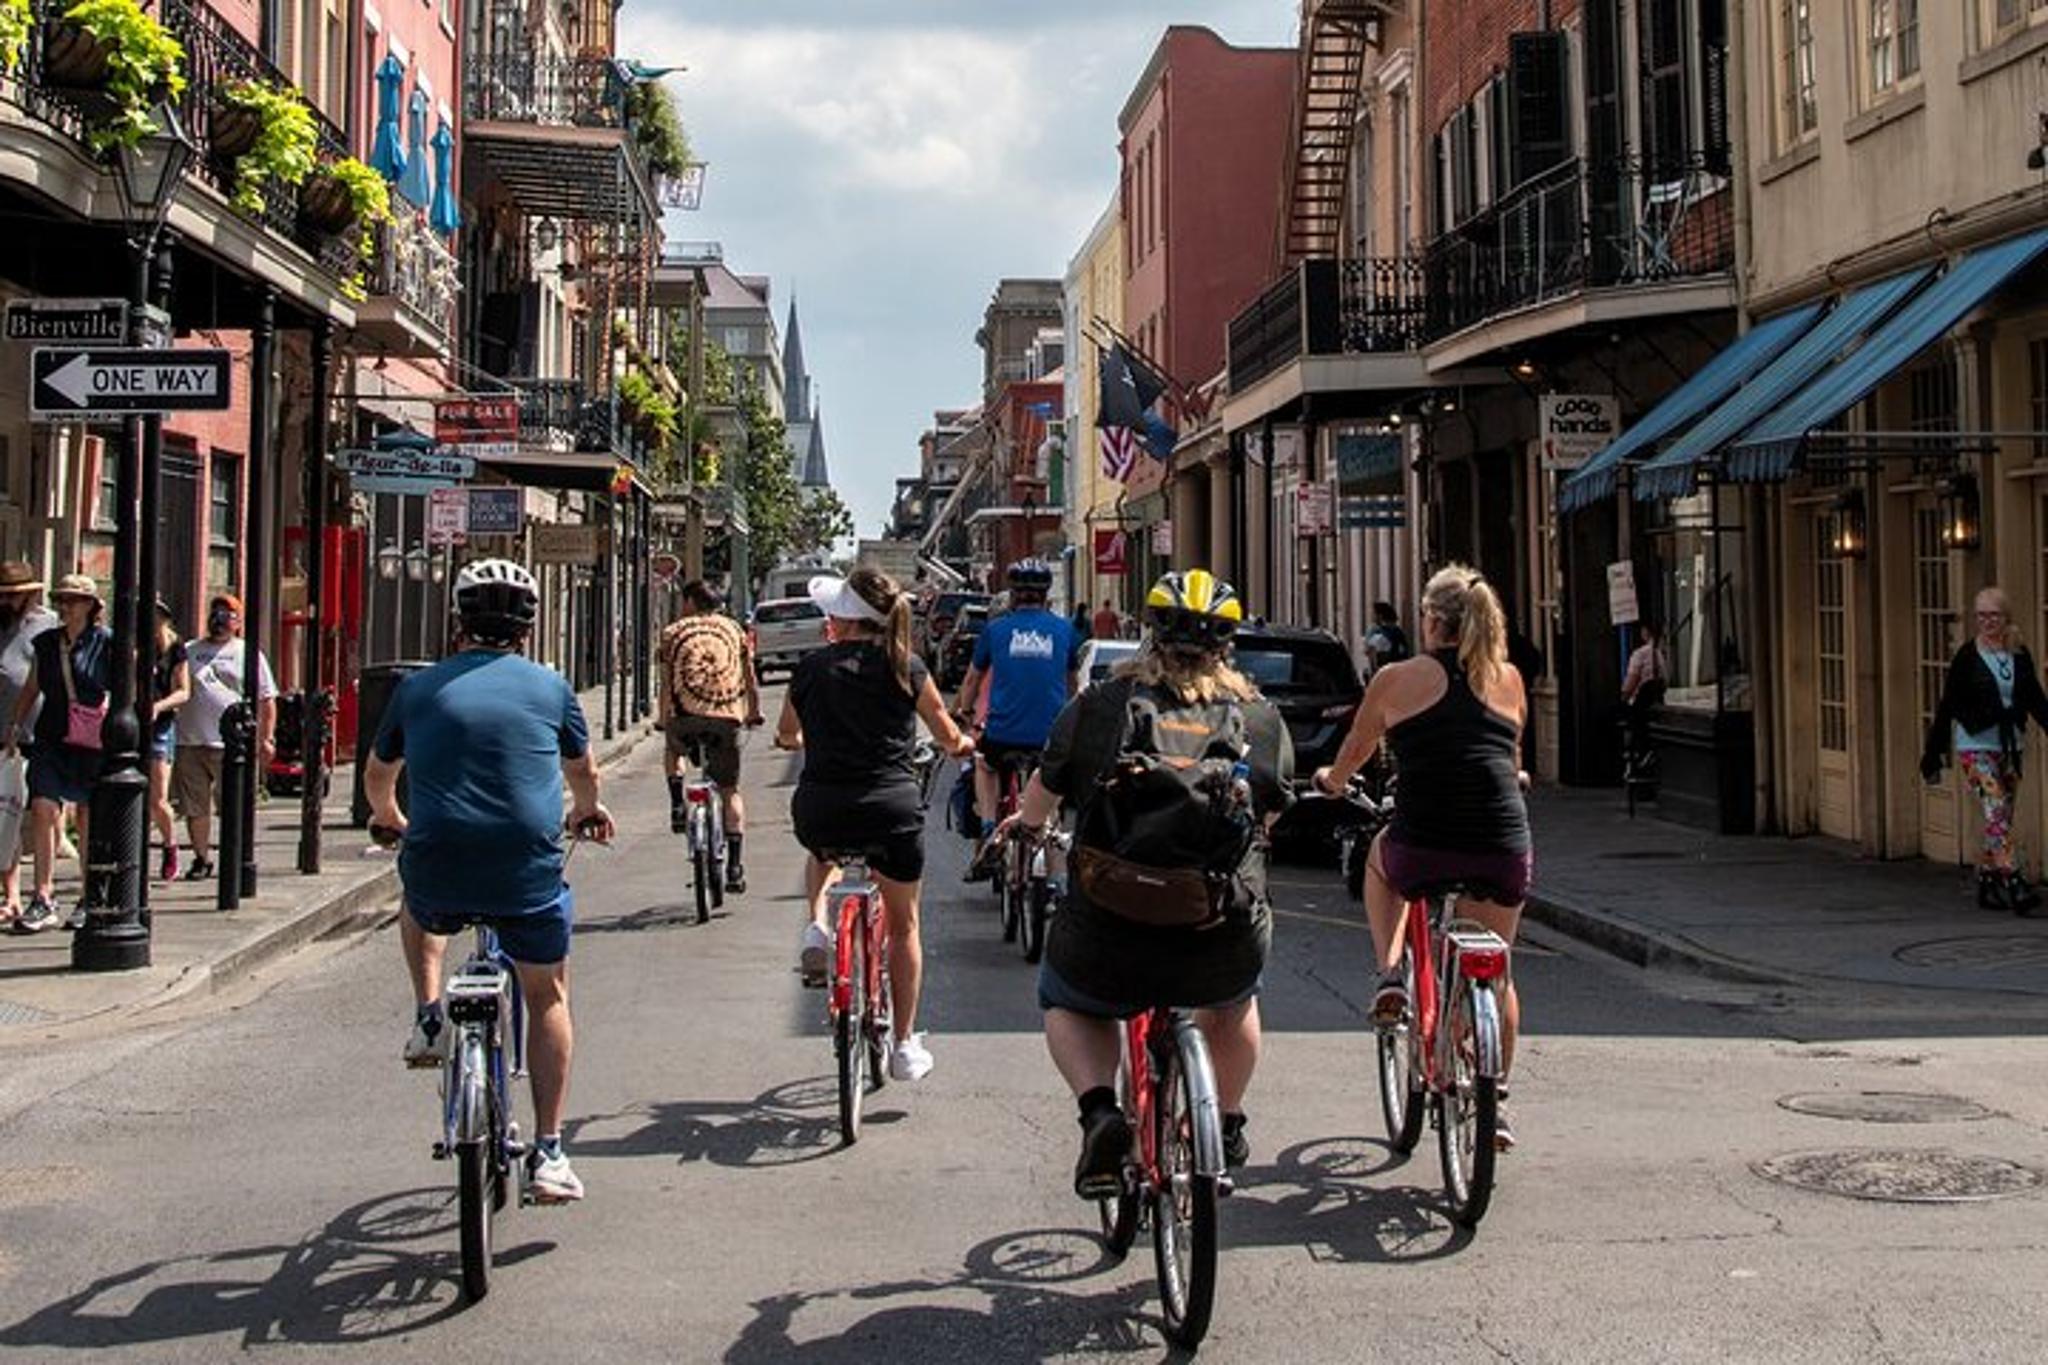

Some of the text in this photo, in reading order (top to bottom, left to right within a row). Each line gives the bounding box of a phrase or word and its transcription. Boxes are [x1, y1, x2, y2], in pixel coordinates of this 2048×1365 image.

[10, 312, 122, 337] Bienville
[93, 368, 209, 391] ONE WAY
[473, 403, 513, 419] SALE
[1549, 417, 1613, 434] hands
